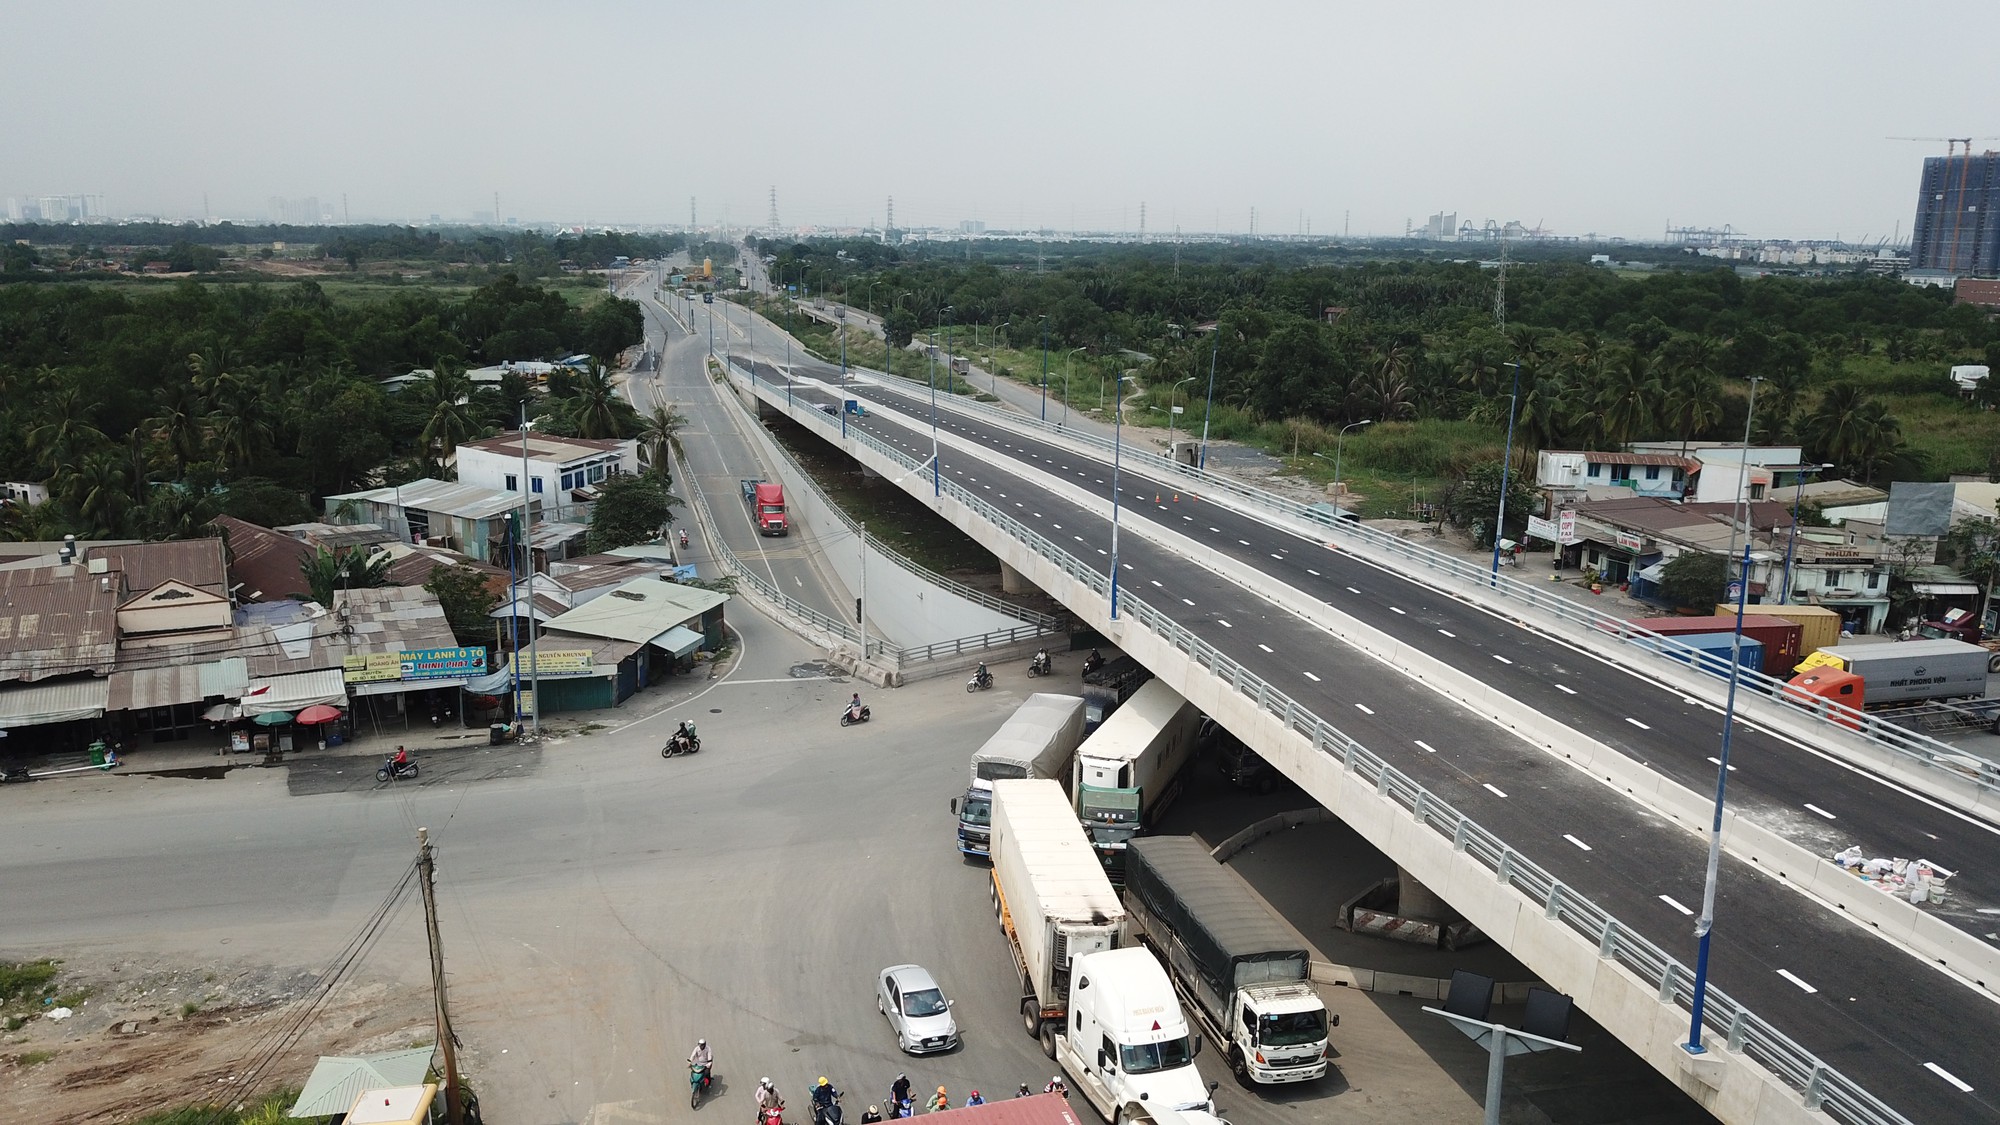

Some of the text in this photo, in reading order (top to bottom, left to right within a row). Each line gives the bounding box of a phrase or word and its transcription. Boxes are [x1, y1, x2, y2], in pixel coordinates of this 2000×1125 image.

[1561, 522, 1573, 530] COPY
[400, 647, 484, 661] MÁY LẠNH Ô TÔ
